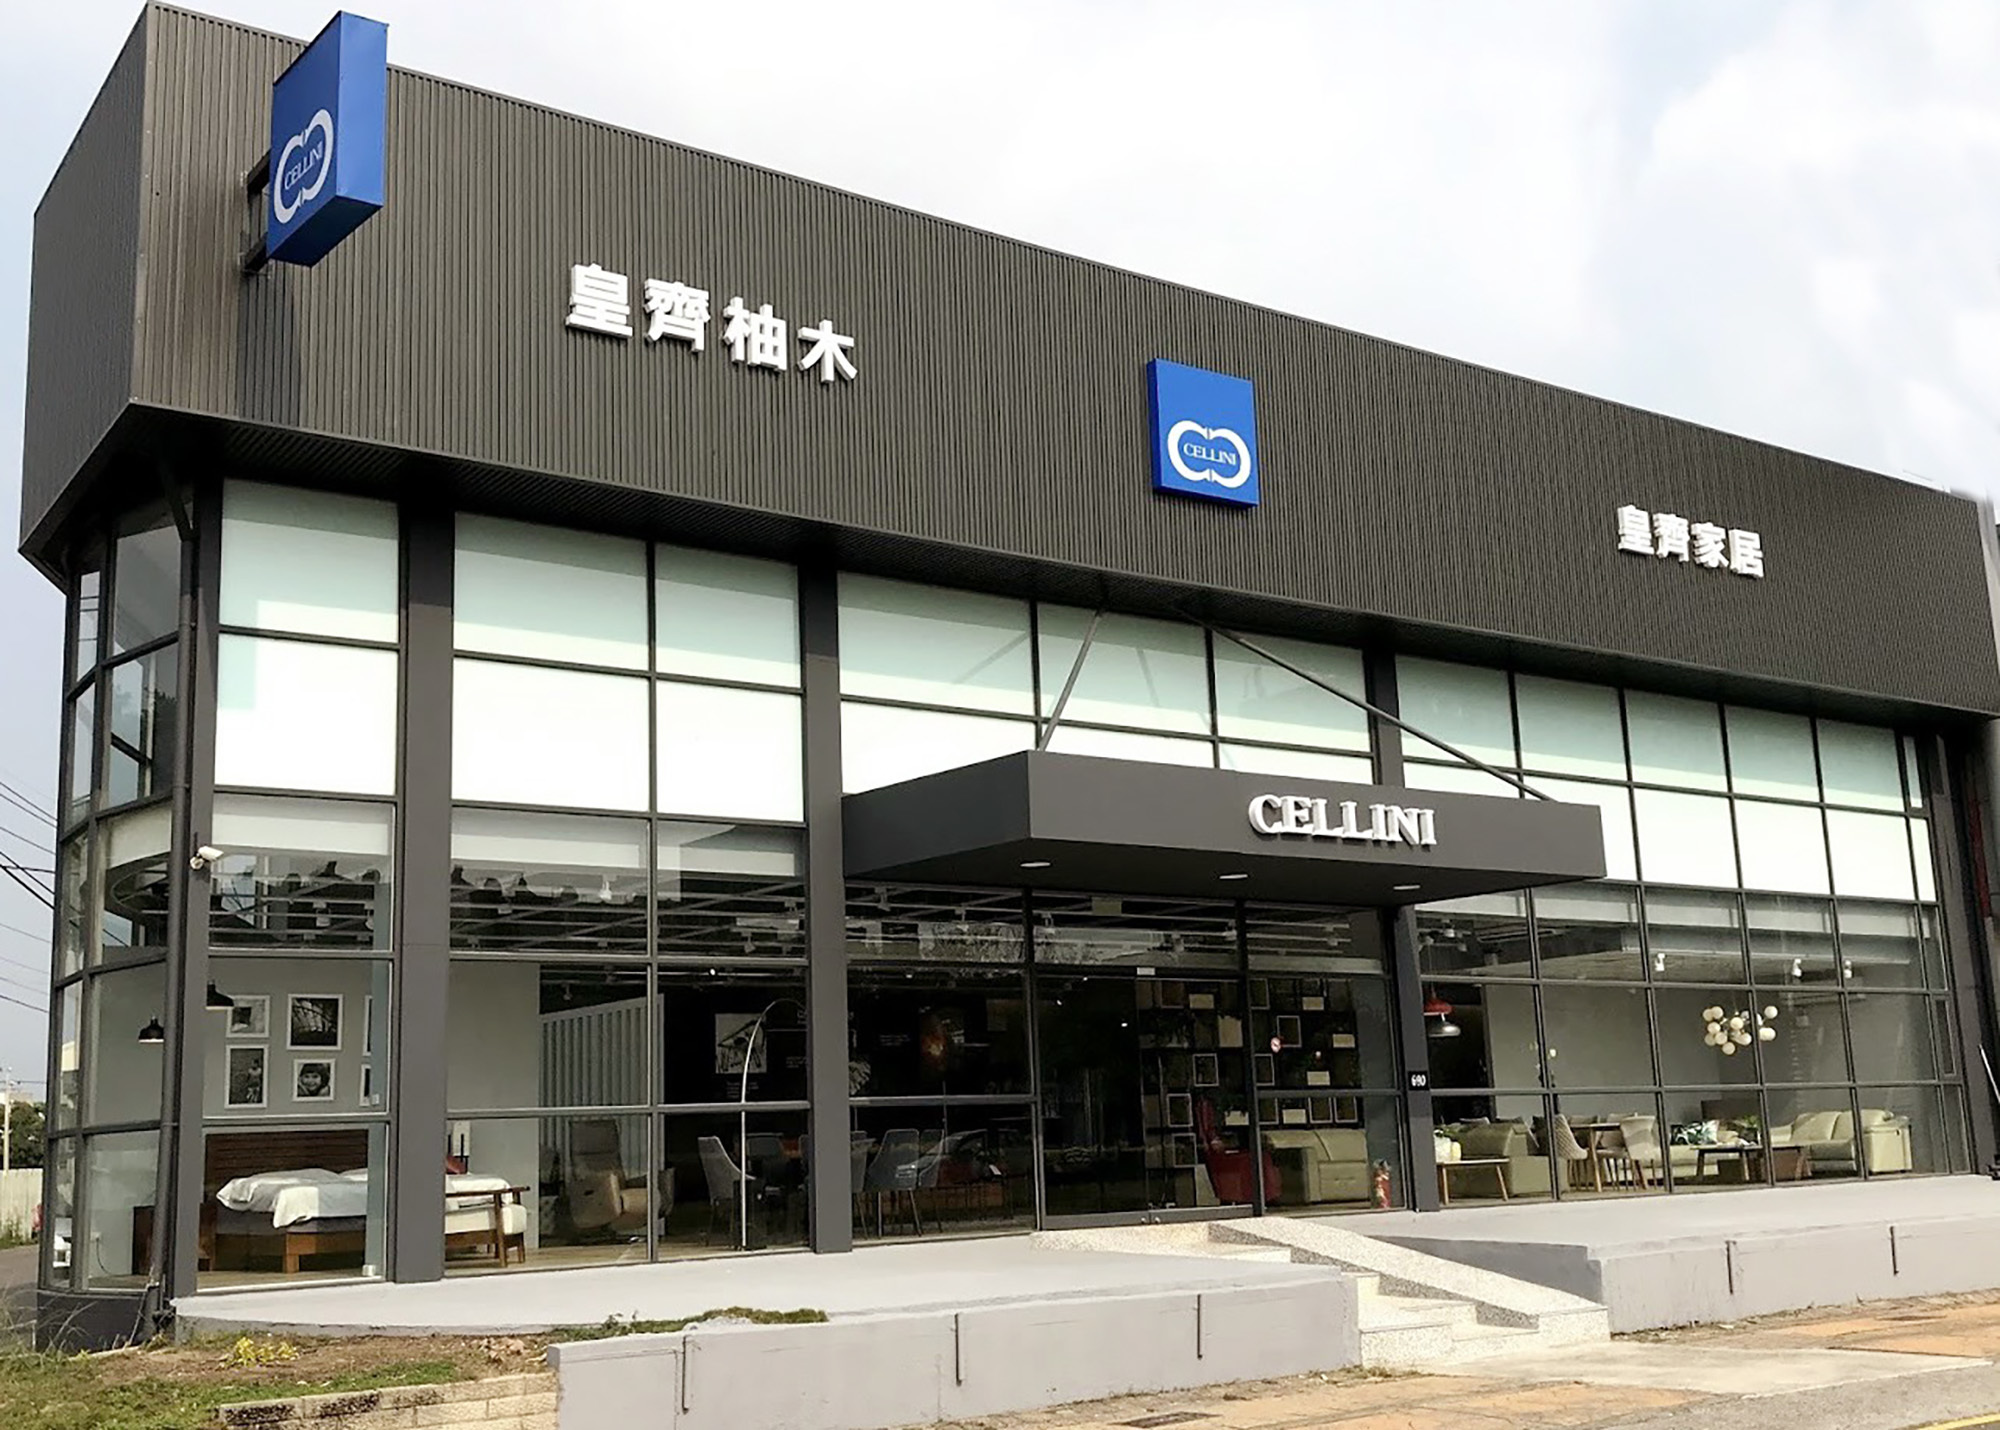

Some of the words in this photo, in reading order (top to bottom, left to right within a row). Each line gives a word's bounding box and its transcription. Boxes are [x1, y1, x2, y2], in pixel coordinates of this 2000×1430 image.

[284, 140, 323, 190] CELLINI
[566, 263, 858, 384] 皇齊柚木
[1183, 442, 1237, 466] CELLINI
[1617, 504, 1764, 578] 皇齊家居
[1248, 794, 1437, 845] CELLINI
